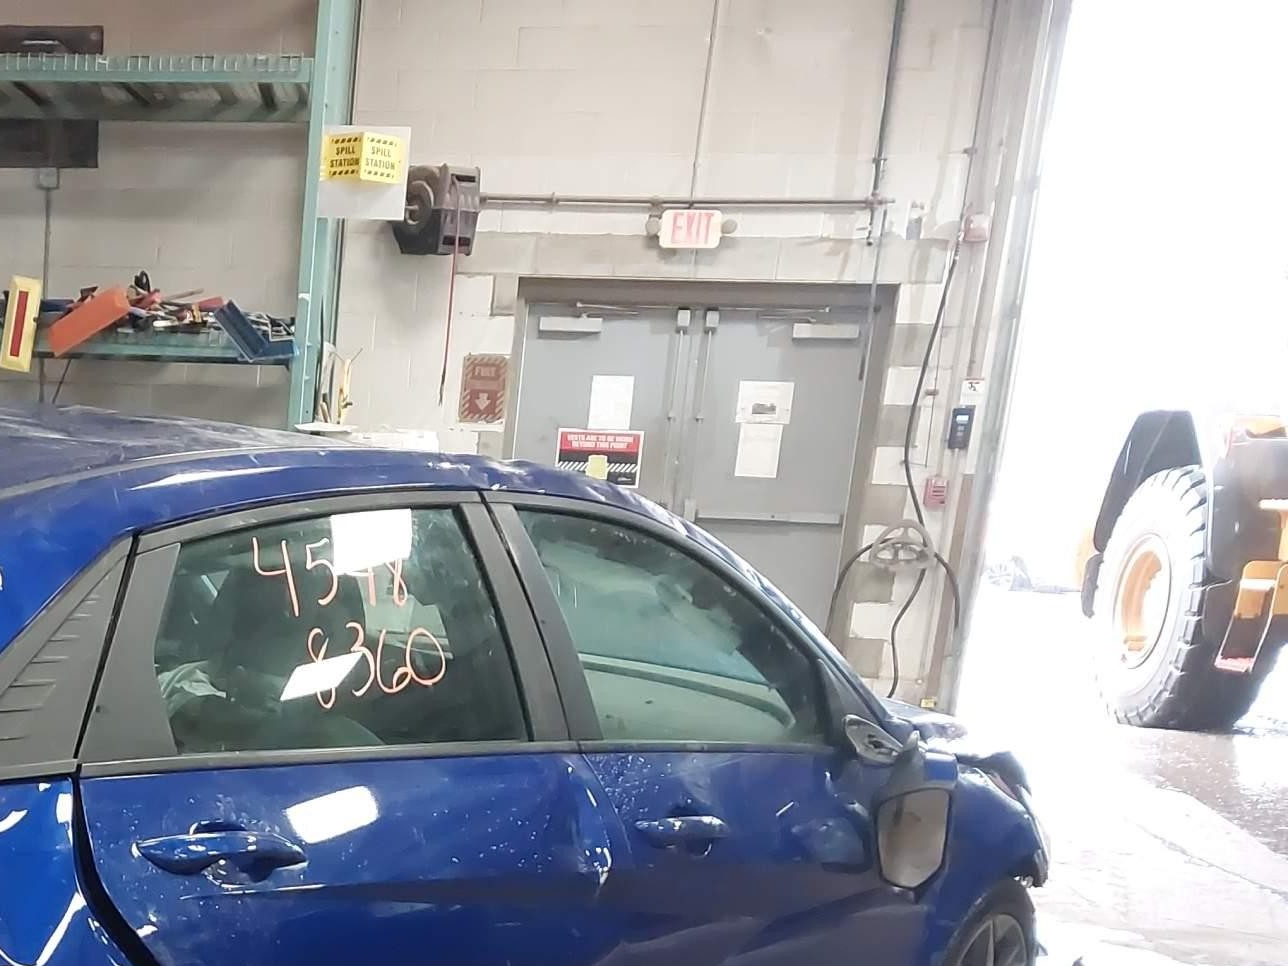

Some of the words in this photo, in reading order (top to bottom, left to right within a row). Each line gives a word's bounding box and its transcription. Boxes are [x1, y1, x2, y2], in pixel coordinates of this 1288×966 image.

[336, 146, 355, 156] SPILL
[371, 146, 392, 158] SPILL
[329, 157, 360, 168] STATION
[365, 157, 396, 170] STATION
[671, 211, 715, 245] EXIT
[307, 621, 446, 710] 8360
